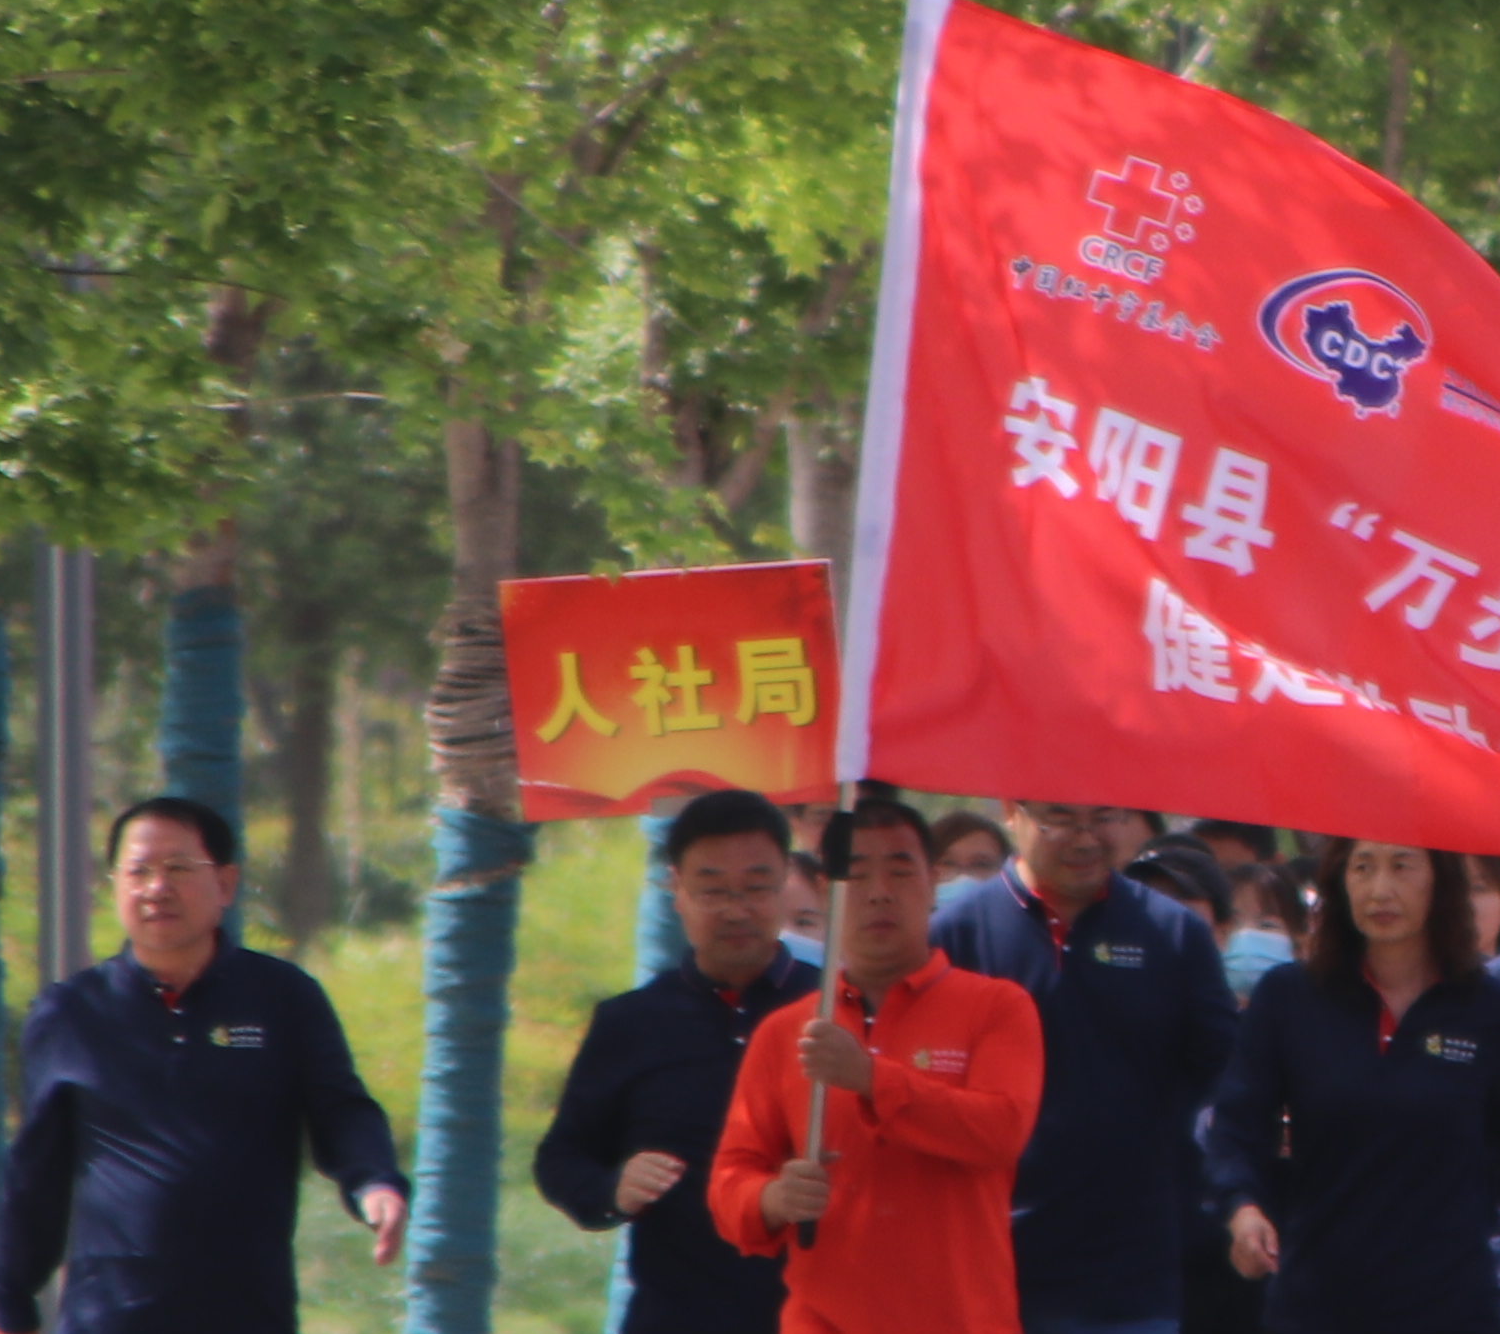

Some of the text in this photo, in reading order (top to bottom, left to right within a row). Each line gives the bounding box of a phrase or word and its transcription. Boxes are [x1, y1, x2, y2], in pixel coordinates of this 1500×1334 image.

[1078, 234, 1164, 284] CRCF
[1010, 255, 1221, 352] 中国红十字基金会
[1320, 330, 1393, 380] CDC
[536, 637, 817, 744] 人社局
